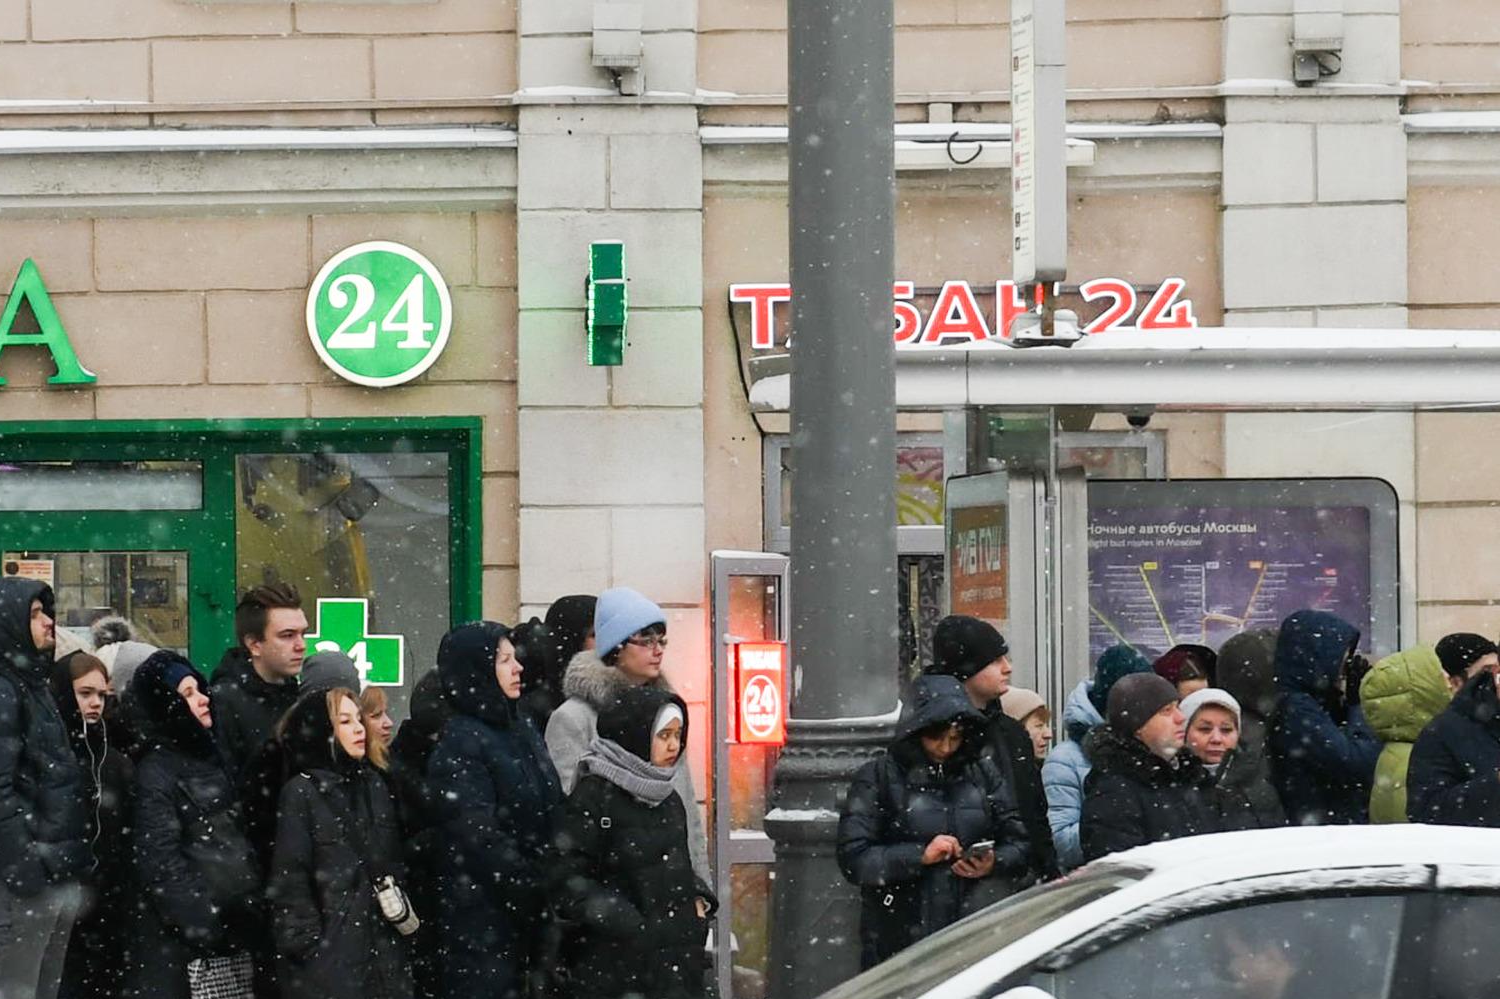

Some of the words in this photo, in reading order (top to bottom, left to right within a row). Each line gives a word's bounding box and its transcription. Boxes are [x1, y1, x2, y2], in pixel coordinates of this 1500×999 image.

[325, 272, 436, 351] 24
[1138, 522, 1201, 536] автобусы
[1203, 522, 1258, 534] Москвы
[747, 684, 774, 714] 24
